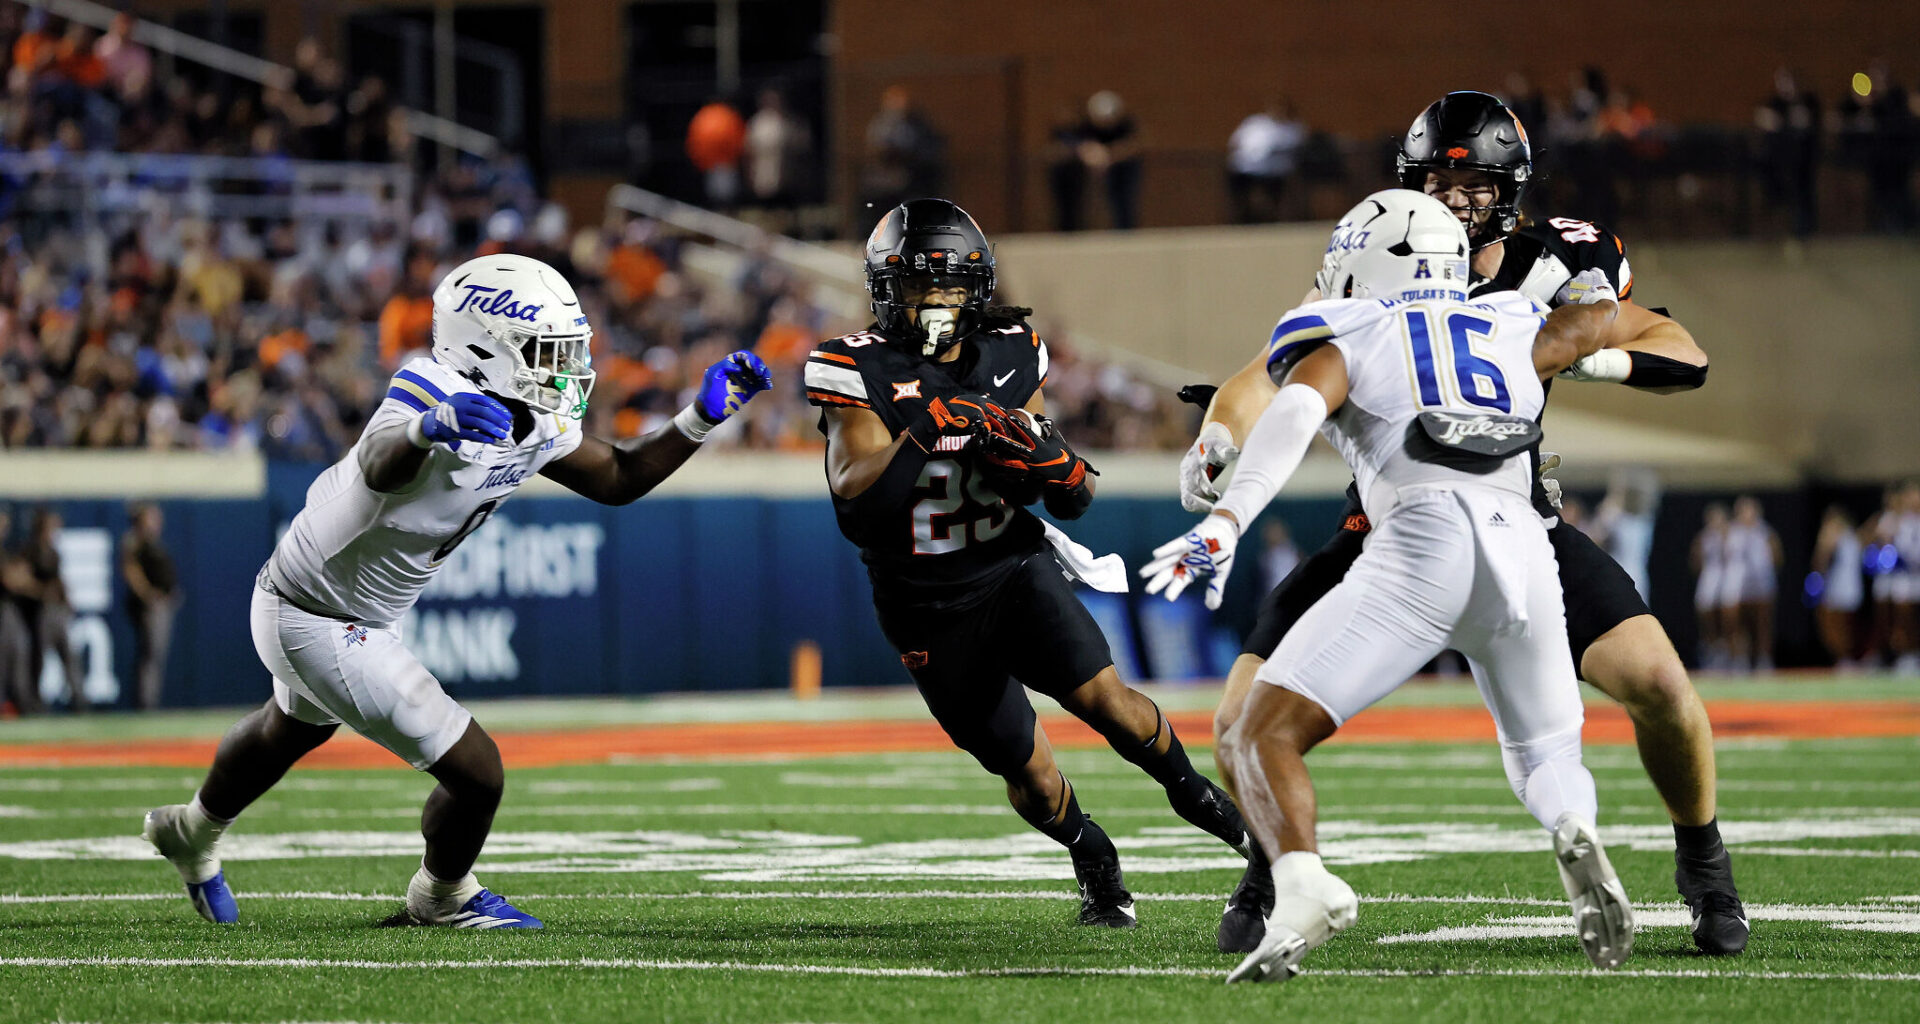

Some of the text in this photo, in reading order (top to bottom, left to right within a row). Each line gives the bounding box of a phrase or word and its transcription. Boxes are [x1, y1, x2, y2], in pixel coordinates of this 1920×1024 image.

[453, 284, 541, 323] Tulsa
[1401, 289, 1446, 303] TULSA'S
[1402, 308, 1514, 415] 16
[1424, 411, 1529, 444] Tulsa
[474, 463, 528, 492] Tulsa
[912, 459, 1015, 555] 25
